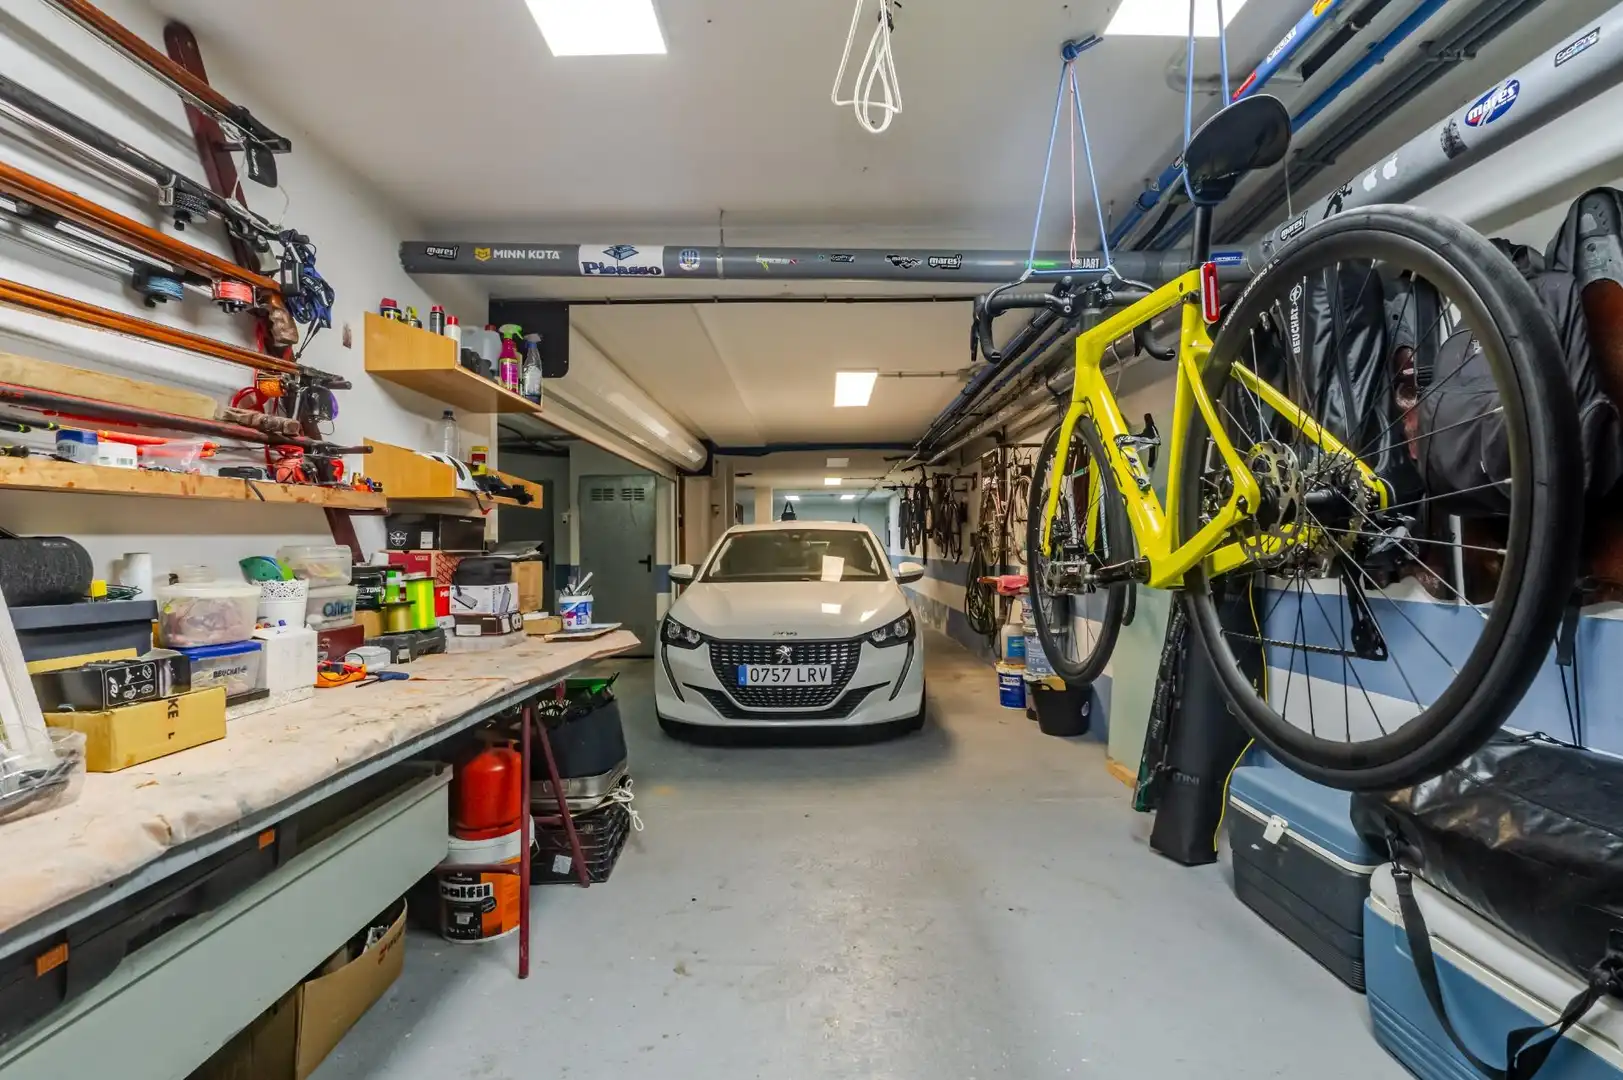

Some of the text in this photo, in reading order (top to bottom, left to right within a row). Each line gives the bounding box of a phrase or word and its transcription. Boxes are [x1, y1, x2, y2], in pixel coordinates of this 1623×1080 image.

[1557, 31, 1598, 60] GoPro
[1468, 86, 1515, 121] mares
[427, 246, 454, 256] mares
[493, 249, 560, 260] MINN KOTA
[929, 257, 958, 267] mares
[1290, 306, 1301, 354] BEUCHAT
[213, 667, 241, 679] BEUCHAT
[750, 668, 827, 683] 0757 LRV
